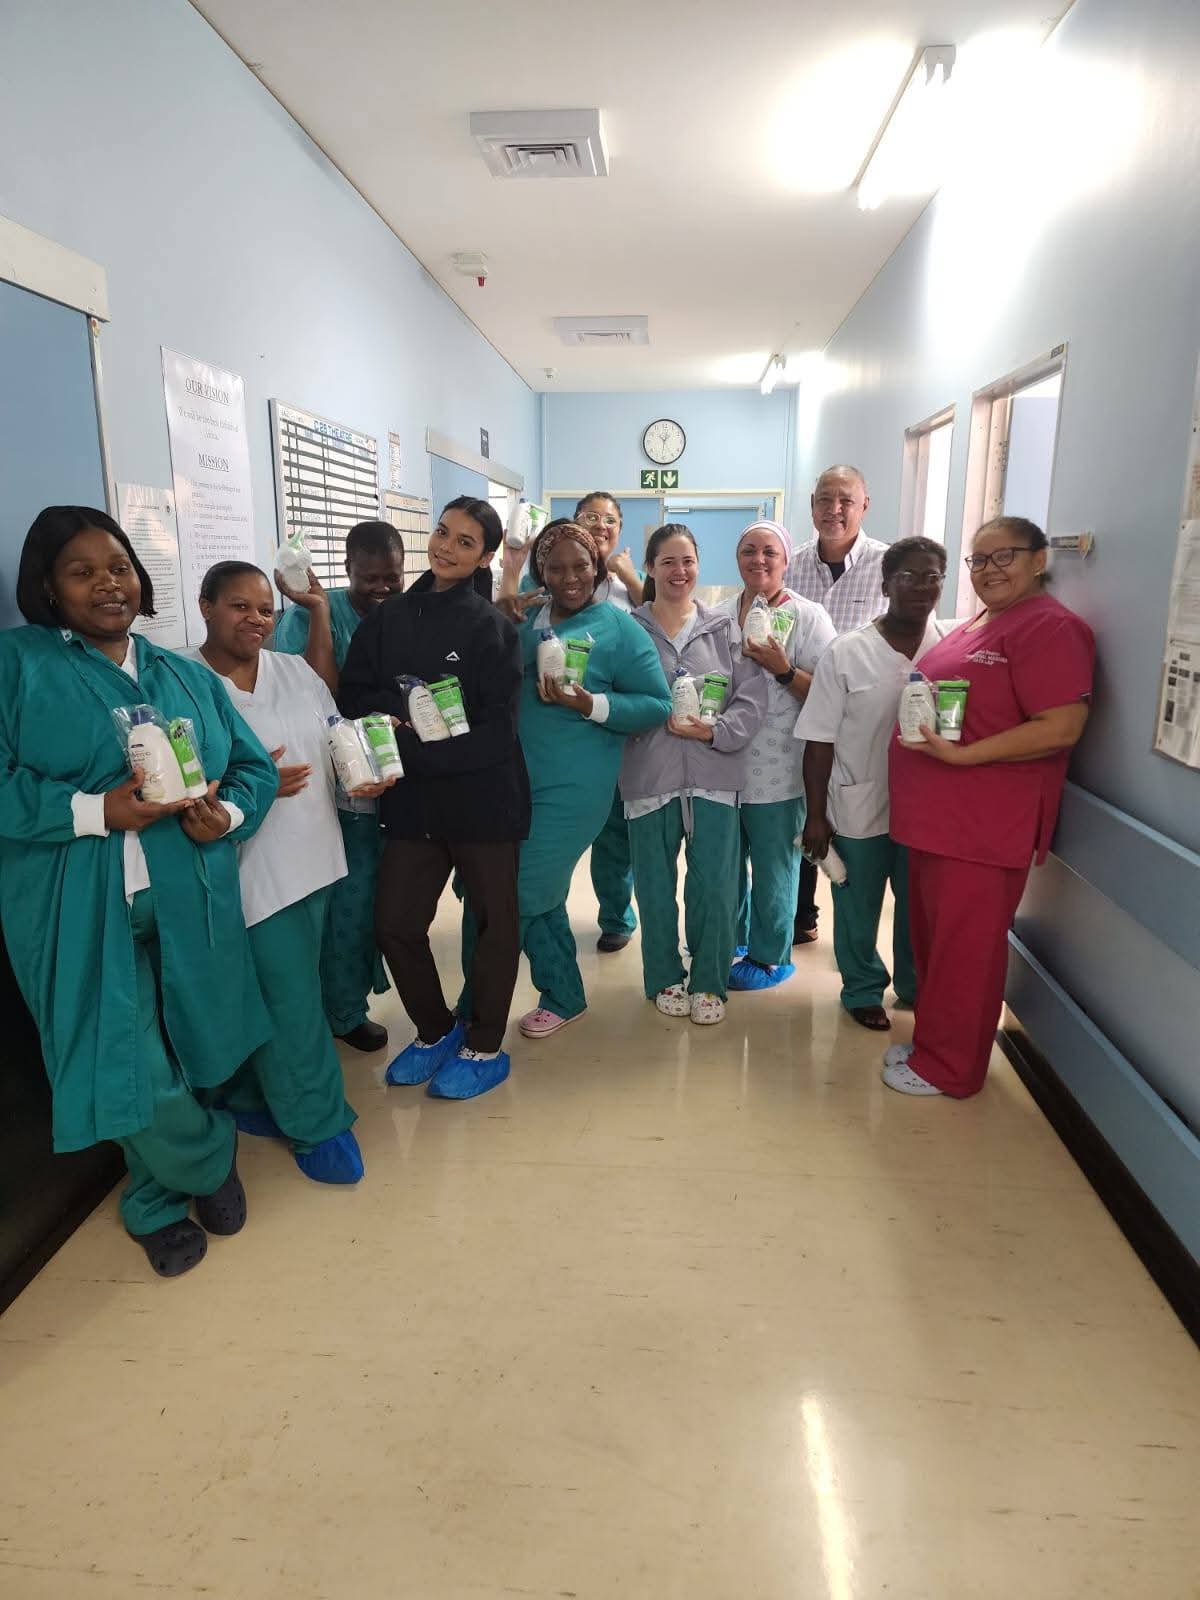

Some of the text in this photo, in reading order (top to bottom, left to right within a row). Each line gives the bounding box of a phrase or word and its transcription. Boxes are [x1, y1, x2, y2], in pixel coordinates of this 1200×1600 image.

[185, 377, 230, 404] OUR VISION
[198, 453, 229, 471] MISSION
